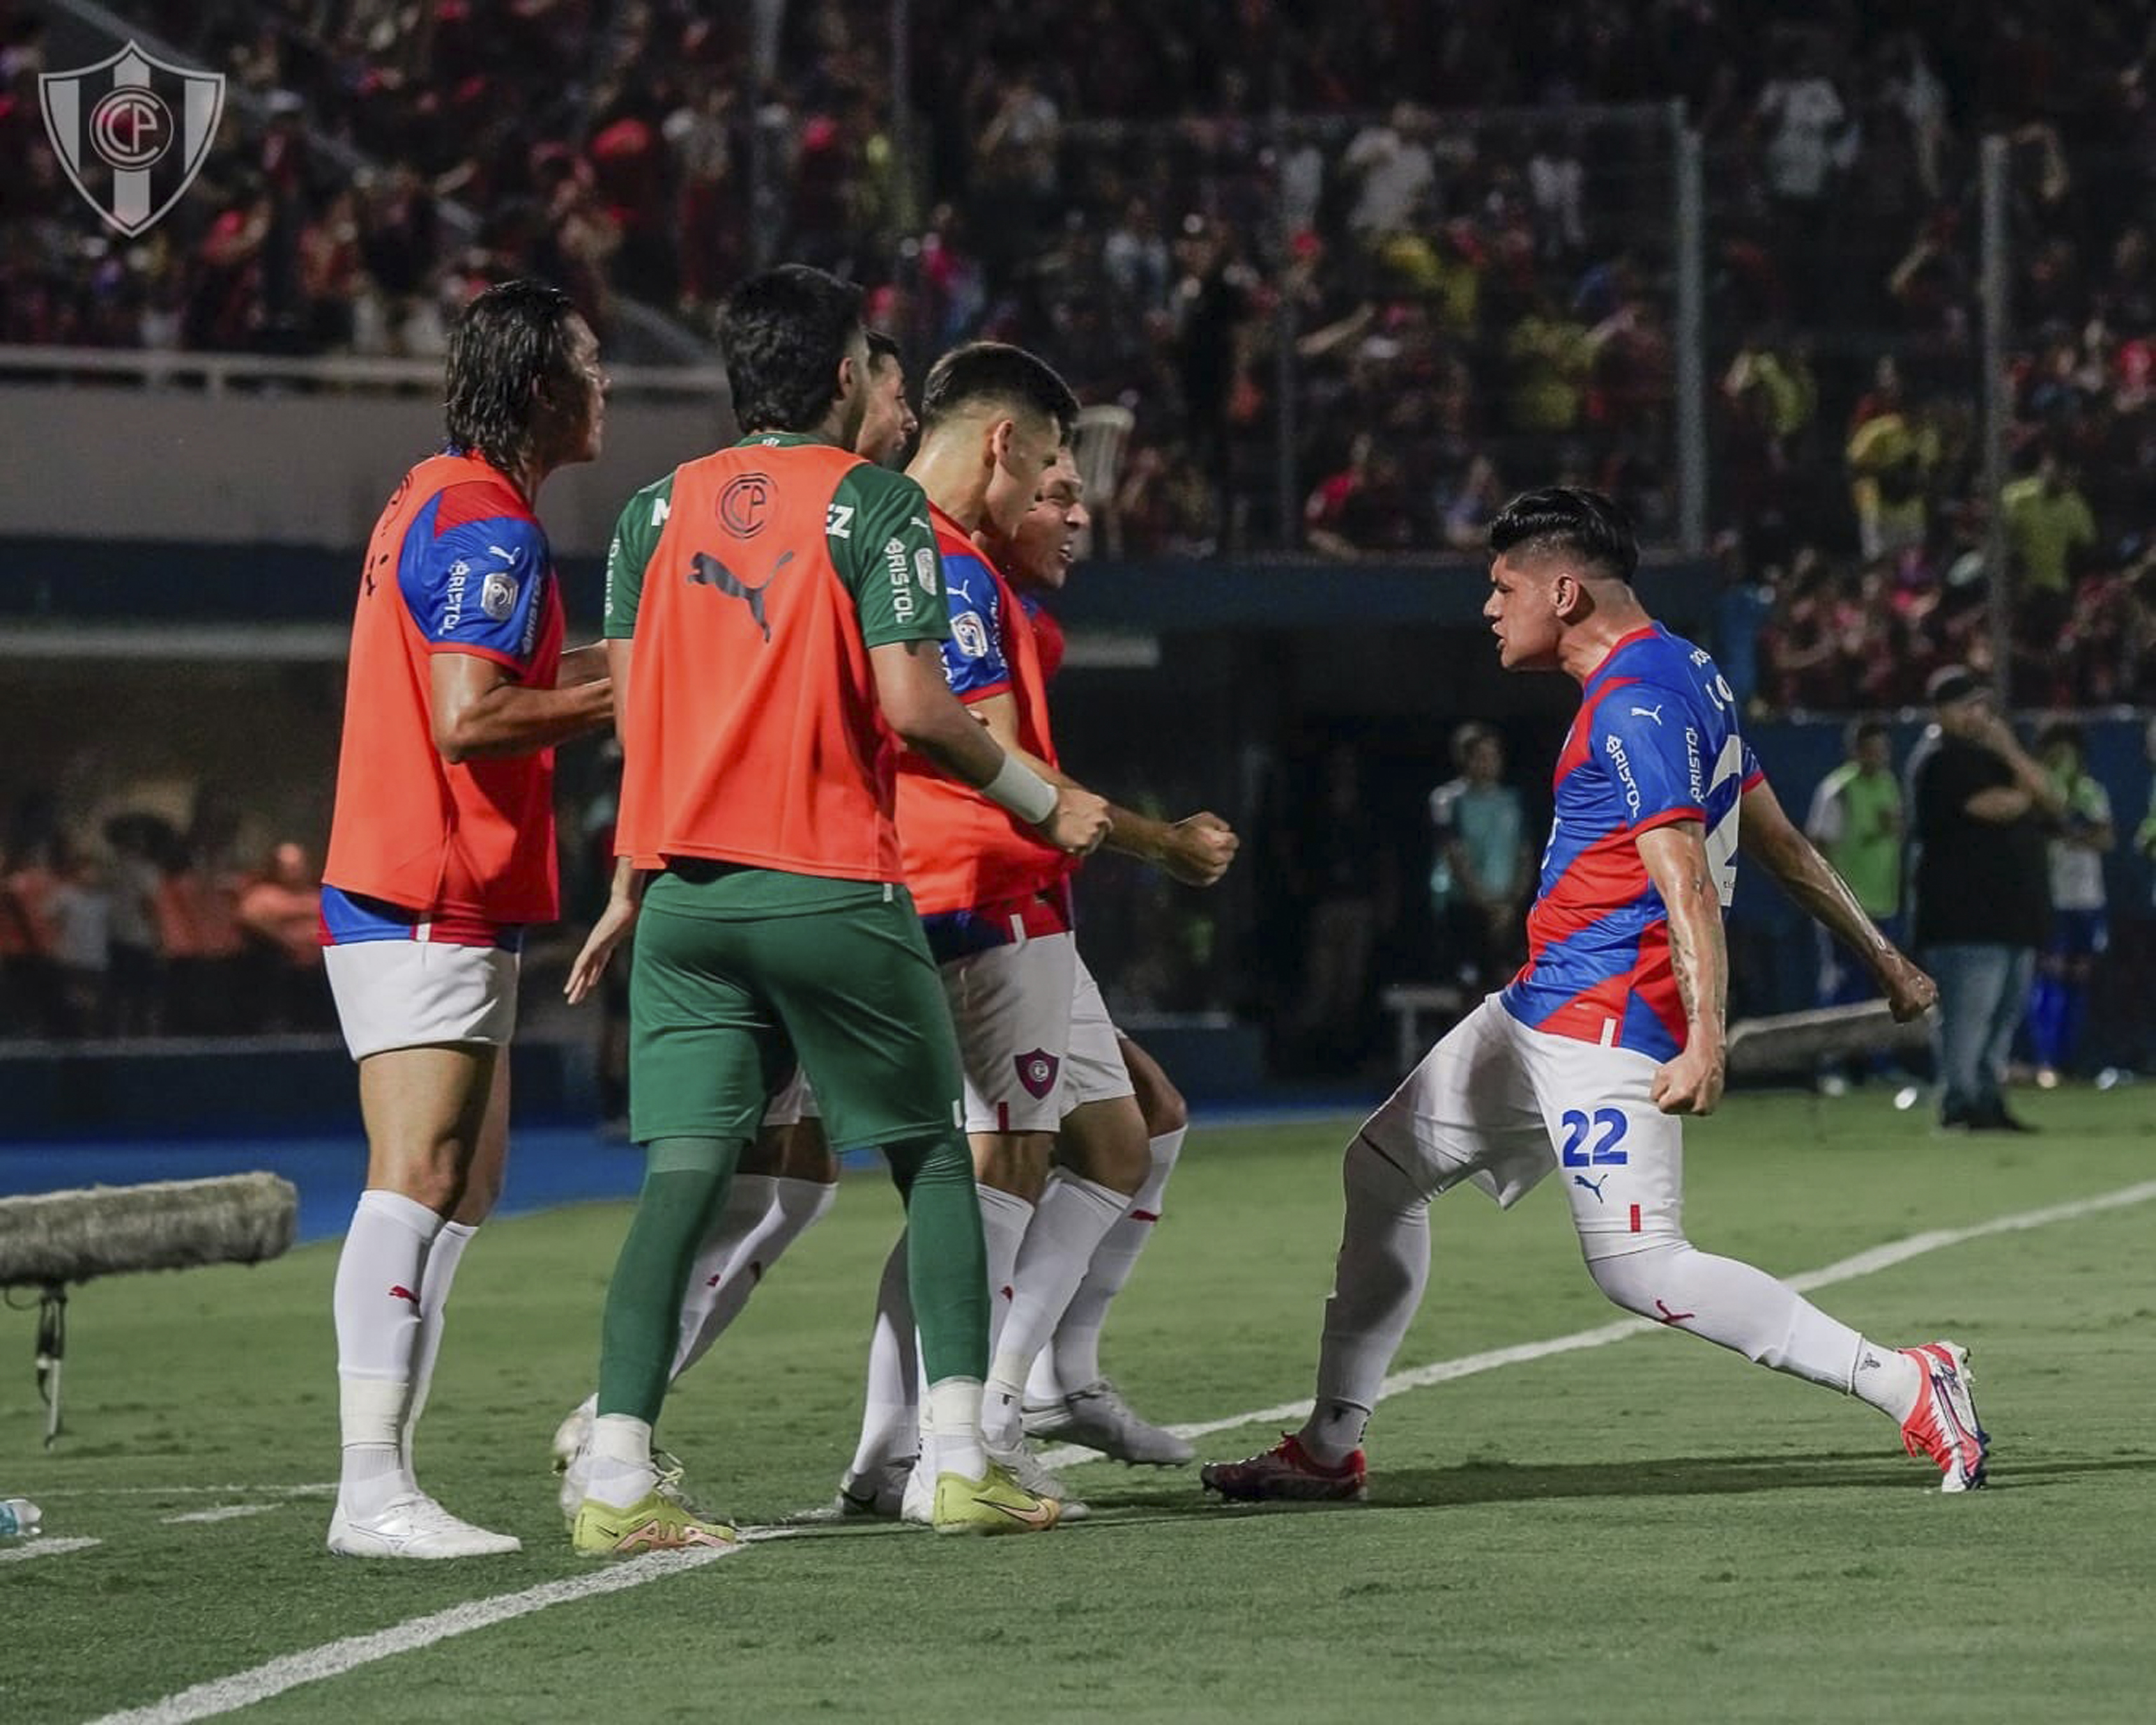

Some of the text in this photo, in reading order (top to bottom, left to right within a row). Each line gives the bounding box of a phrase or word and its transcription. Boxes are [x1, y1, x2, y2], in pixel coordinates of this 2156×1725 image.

[884, 538, 914, 624] BRISTOL
[1606, 735, 1641, 818] BRISTOL
[1561, 1107, 1628, 1168] 22
